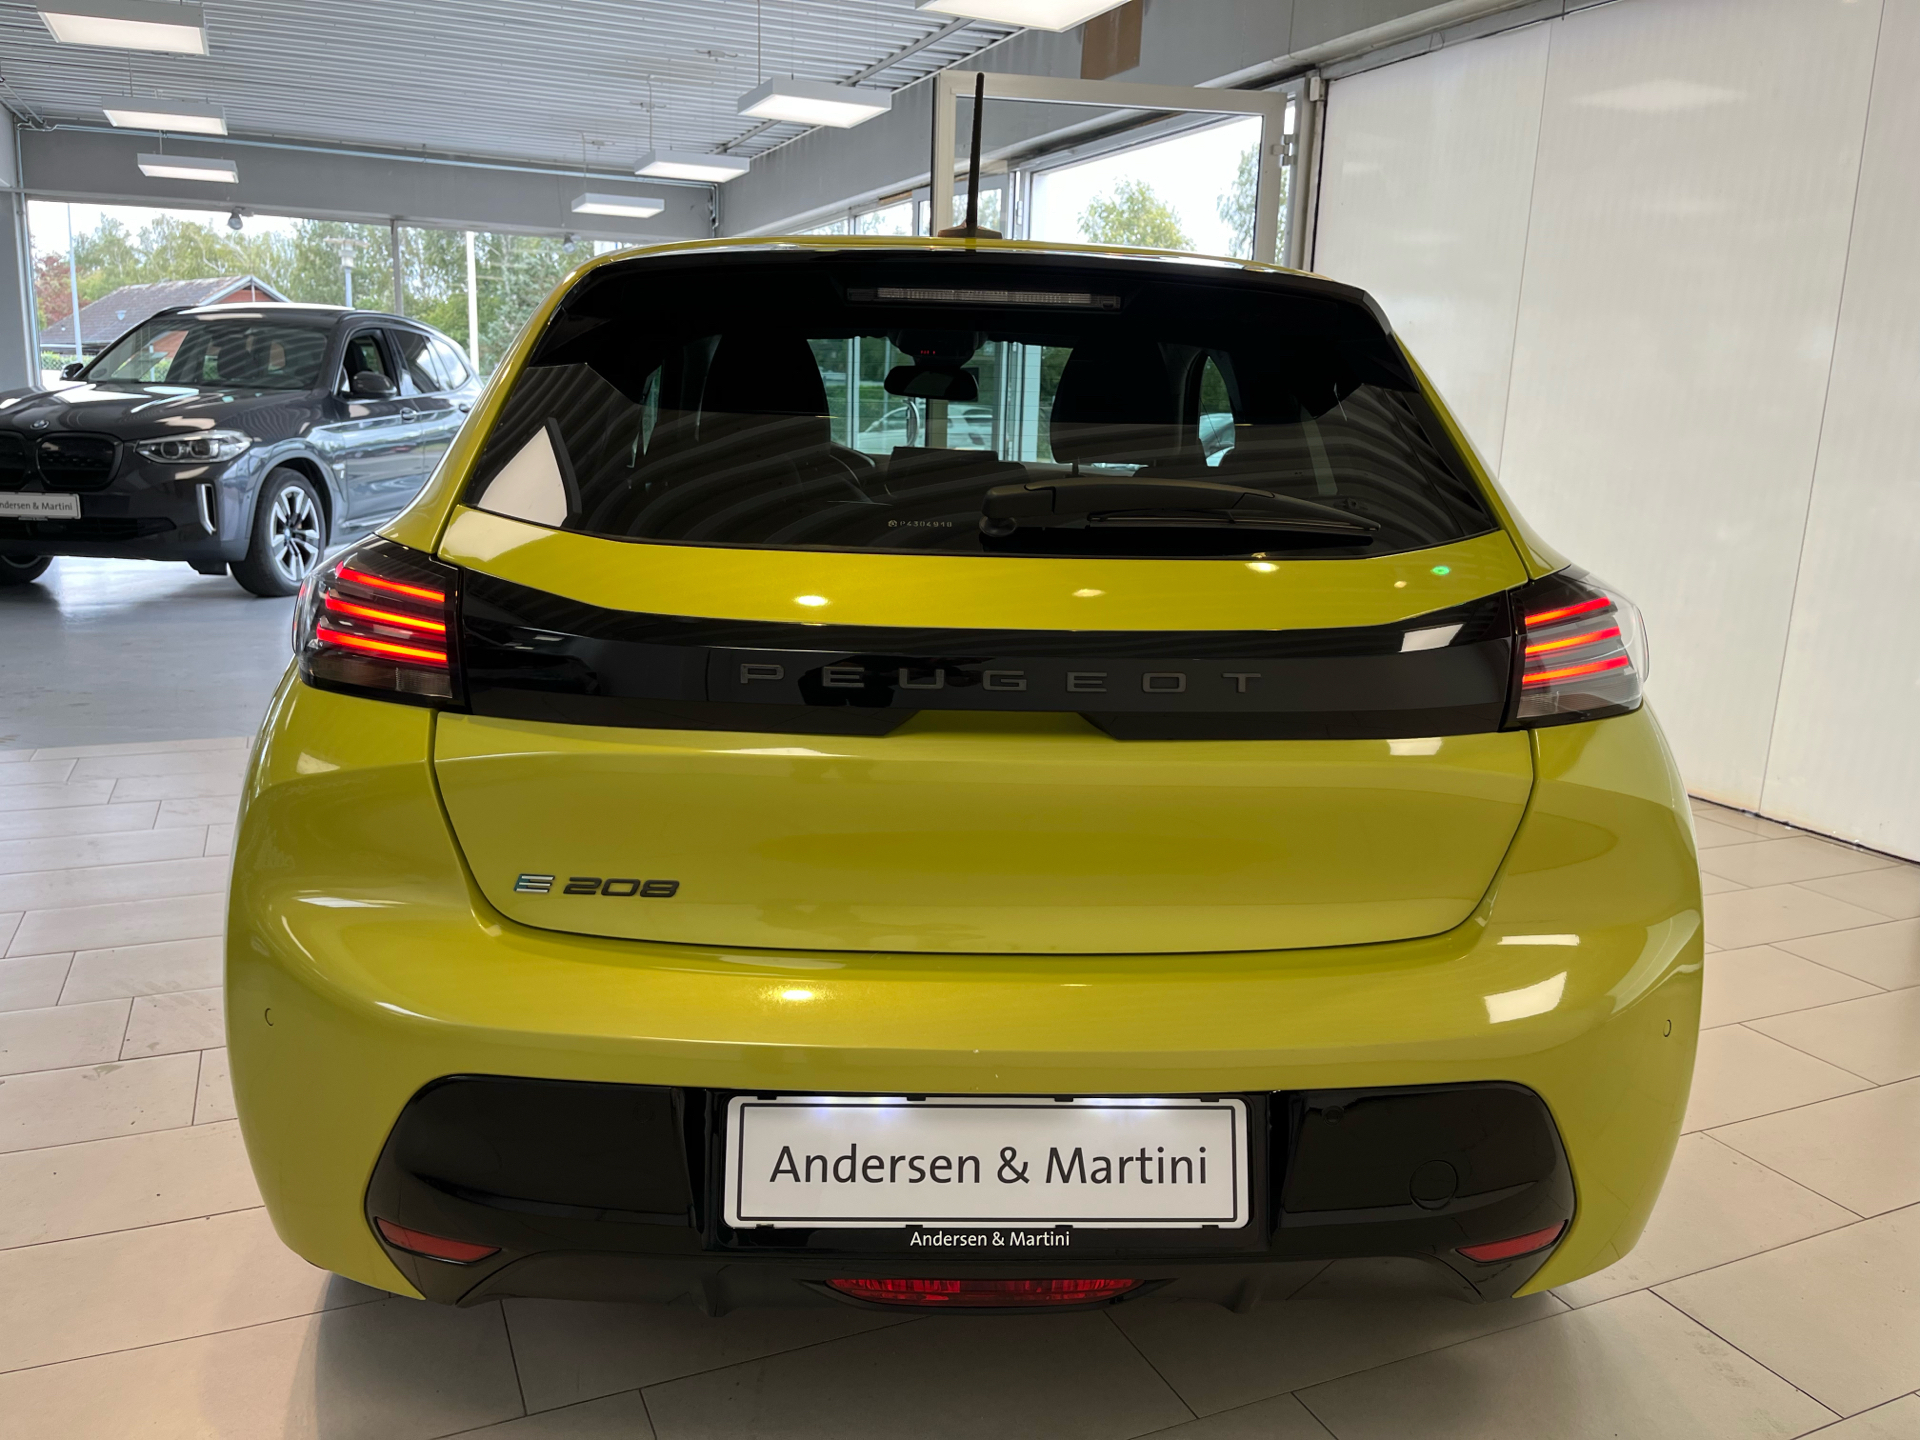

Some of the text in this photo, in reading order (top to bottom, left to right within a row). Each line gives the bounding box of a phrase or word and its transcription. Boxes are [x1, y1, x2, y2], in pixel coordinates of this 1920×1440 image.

[0, 501, 73, 511] ndersen & Martini
[740, 663, 1262, 693] PEUGEOT
[513, 873, 680, 898] E 208
[769, 1143, 1207, 1185] Andersen & Martini
[909, 1230, 1071, 1247] Andersen & Martini
